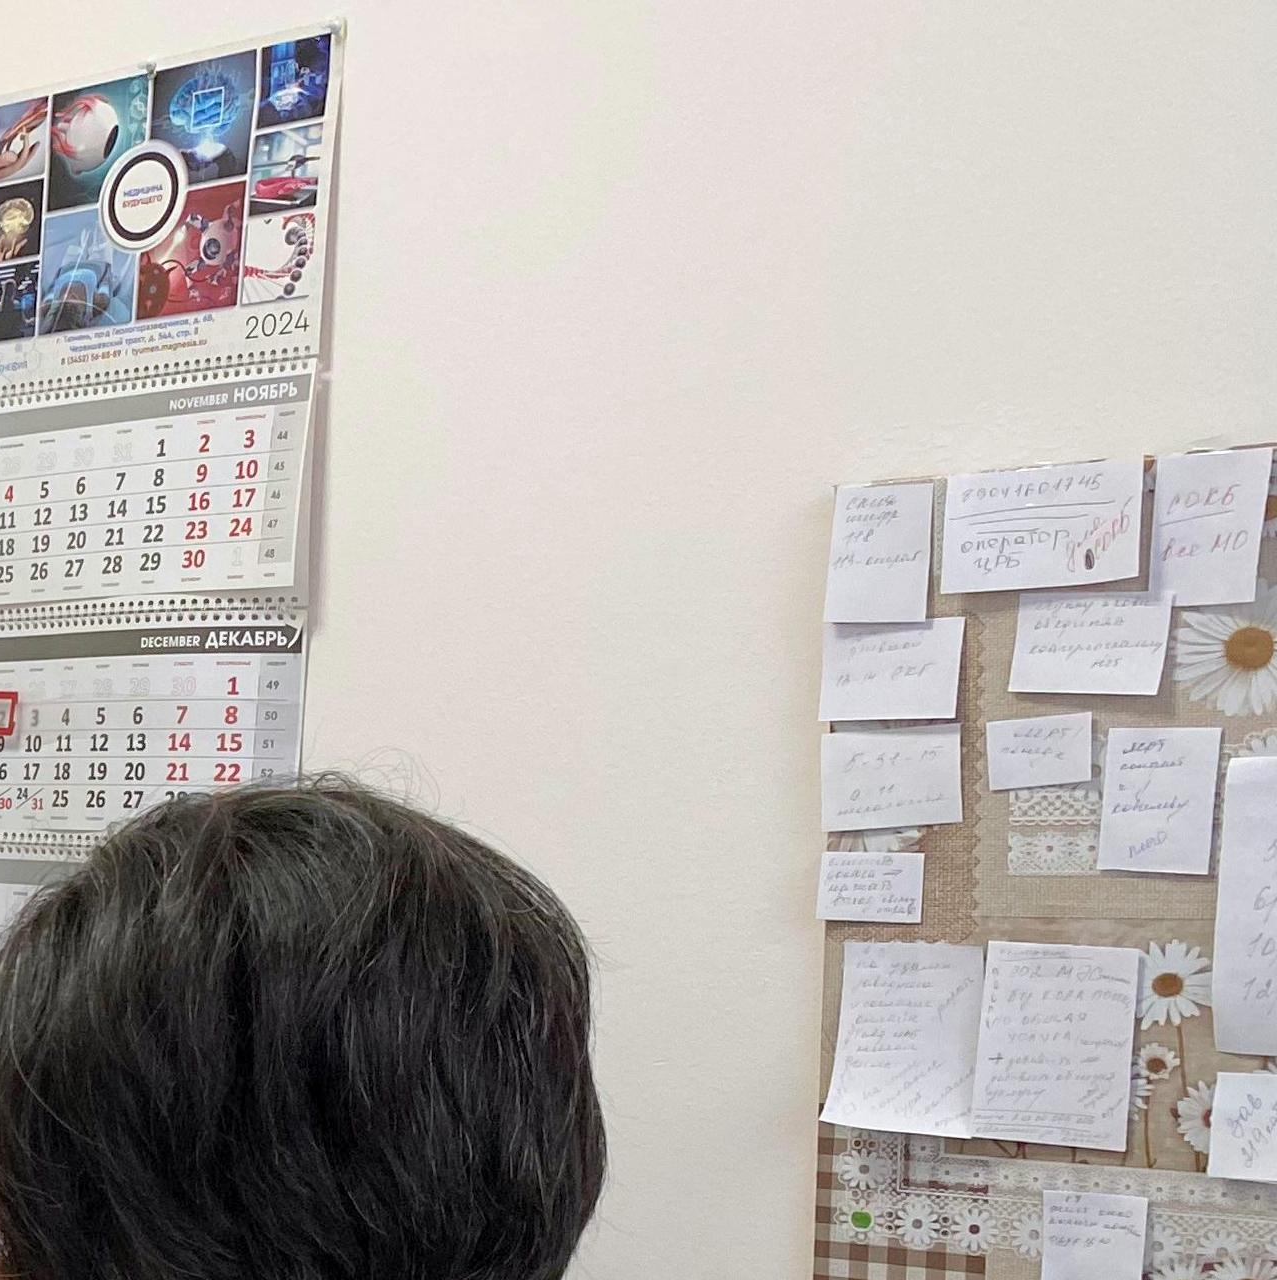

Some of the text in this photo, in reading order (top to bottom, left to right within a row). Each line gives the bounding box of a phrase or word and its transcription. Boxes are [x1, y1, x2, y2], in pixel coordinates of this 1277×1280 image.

[245, 310, 310, 341] 2024
[169, 382, 298, 412] NOVEMBER НОЯБРЬ
[157, 429, 288, 457] 1 2 3 44
[4, 459, 285, 502] 4 5 6 7 8 9 10 45
[33, 508, 52, 526] 12
[69, 503, 88, 522] 13
[107, 499, 127, 518] 14
[146, 495, 166, 515] 15
[188, 492, 210, 511] 16
[232, 488, 256, 508] 17
[32, 535, 50, 553] 19
[67, 531, 87, 550] 20
[104, 528, 125, 547] 21
[143, 524, 164, 543] 22
[185, 520, 208, 540] 23
[229, 517, 252, 537] 24
[267, 519, 278, 528] 47
[29, 562, 48, 581] 26
[64, 559, 84, 578] 27
[102, 556, 123, 574] 28
[139, 552, 161, 571] 29
[182, 550, 205, 569] 30
[141, 631, 287, 649] DECEMBER ДЕКАБРЬ
[227, 677, 280, 695] 1 49
[31, 710, 39, 727] 3
[61, 708, 70, 726] 4
[95, 707, 106, 725] 5
[133, 706, 143, 724] 6
[176, 706, 188, 724] 7
[224, 705, 238, 725] 8
[264, 711, 277, 720] 50
[25, 735, 42, 752] 10
[56, 735, 72, 752] 11
[90, 734, 109, 752] 12
[126, 733, 146, 751] 13
[168, 733, 191, 751] 14
[216, 733, 242, 752] 15
[262, 740, 275, 749] 51
[23, 763, 40, 780] 17
[54, 763, 71, 780] 18
[88, 762, 107, 780] 19
[125, 762, 145, 781] 20
[166, 762, 189, 781] 21
[213, 763, 241, 782] 22
[260, 768, 273, 778] 52
[17, 788, 28, 799] 24
[31, 798, 43, 810] 31
[52, 790, 69, 808] 25
[86, 790, 106, 808] 26
[123, 791, 144, 808] 27
